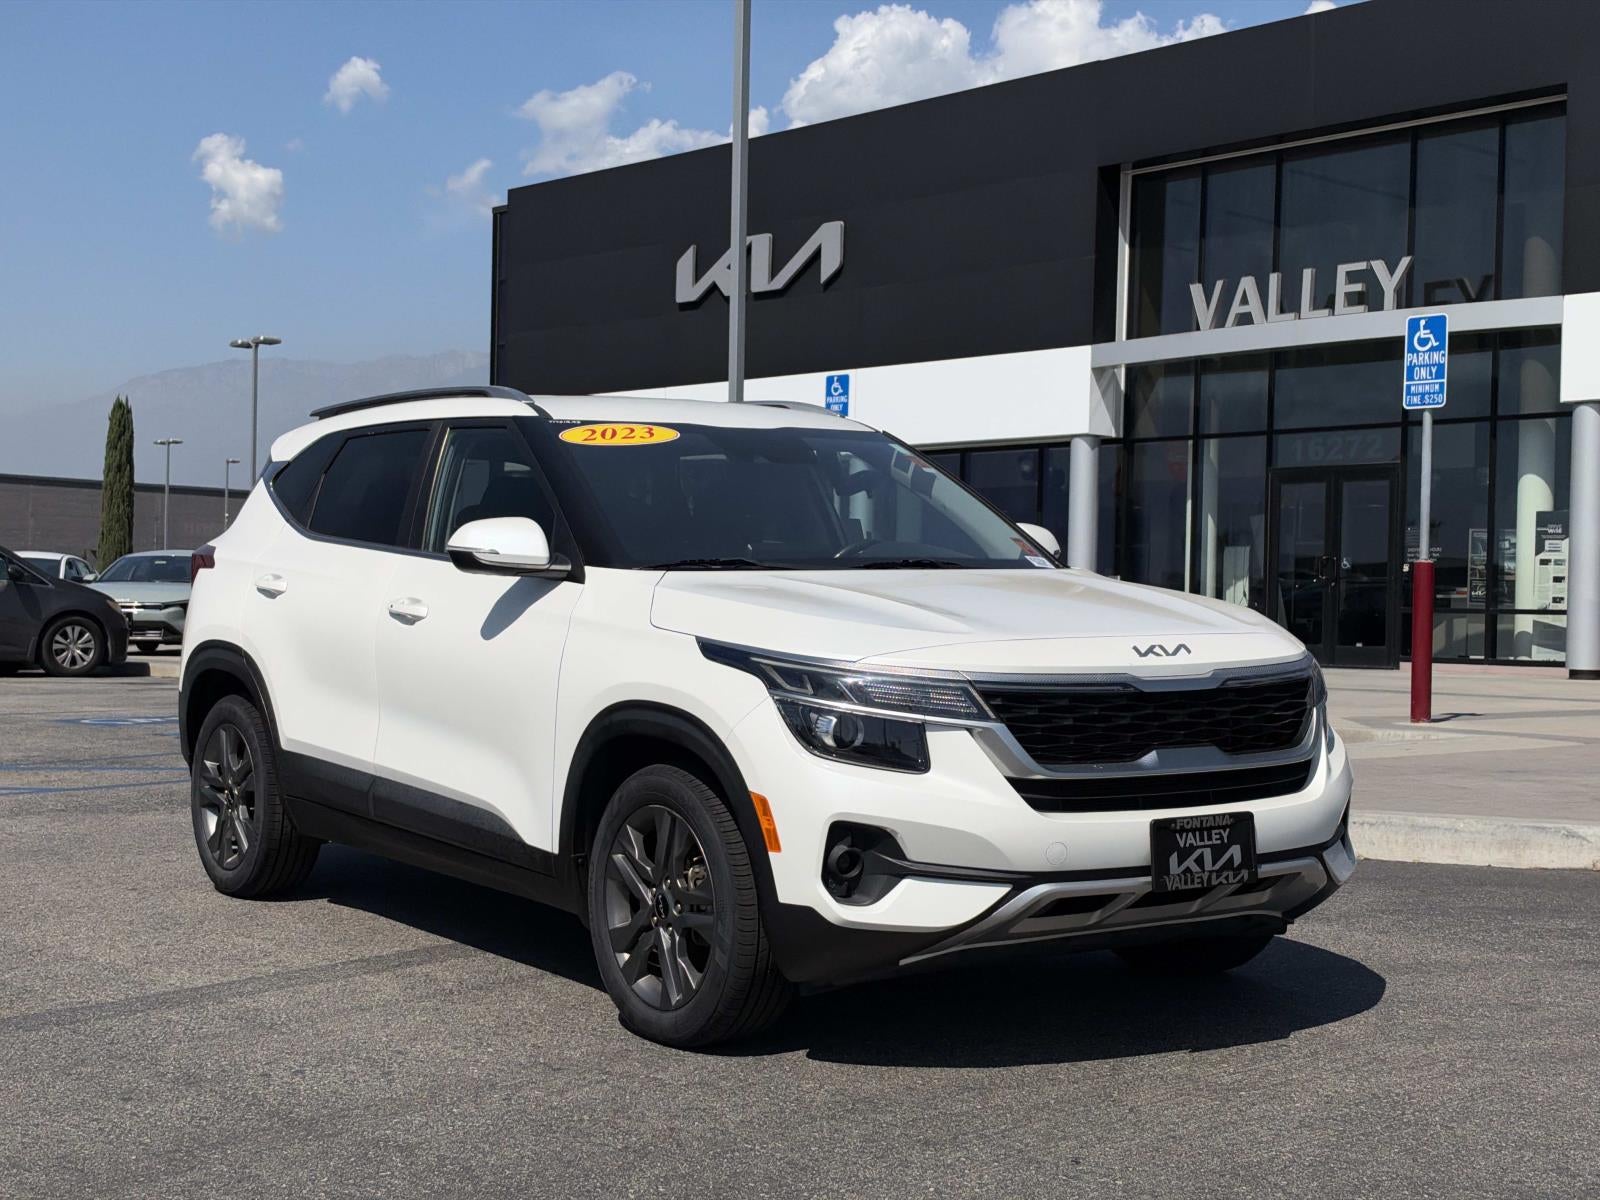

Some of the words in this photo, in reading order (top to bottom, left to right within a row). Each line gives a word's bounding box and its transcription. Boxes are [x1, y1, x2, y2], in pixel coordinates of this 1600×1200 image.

[676, 220, 844, 303] KIA
[1189, 255, 1414, 331] VALLEY
[1408, 351, 1445, 366] PARKING
[1414, 366, 1437, 380] ONLY
[1411, 383, 1439, 394] MINIMUM
[1406, 395, 1421, 405] FINE
[1425, 394, 1443, 404] $250
[581, 426, 655, 442] 2023
[1290, 433, 1384, 462] 16272
[1132, 643, 1192, 657] KIA
[1176, 815, 1231, 830] FONTANA
[1176, 828, 1230, 848] VALLEY
[1169, 844, 1242, 875] KIA
[1163, 872, 1210, 891] VALLEY
[1211, 869, 1249, 886] KIA
